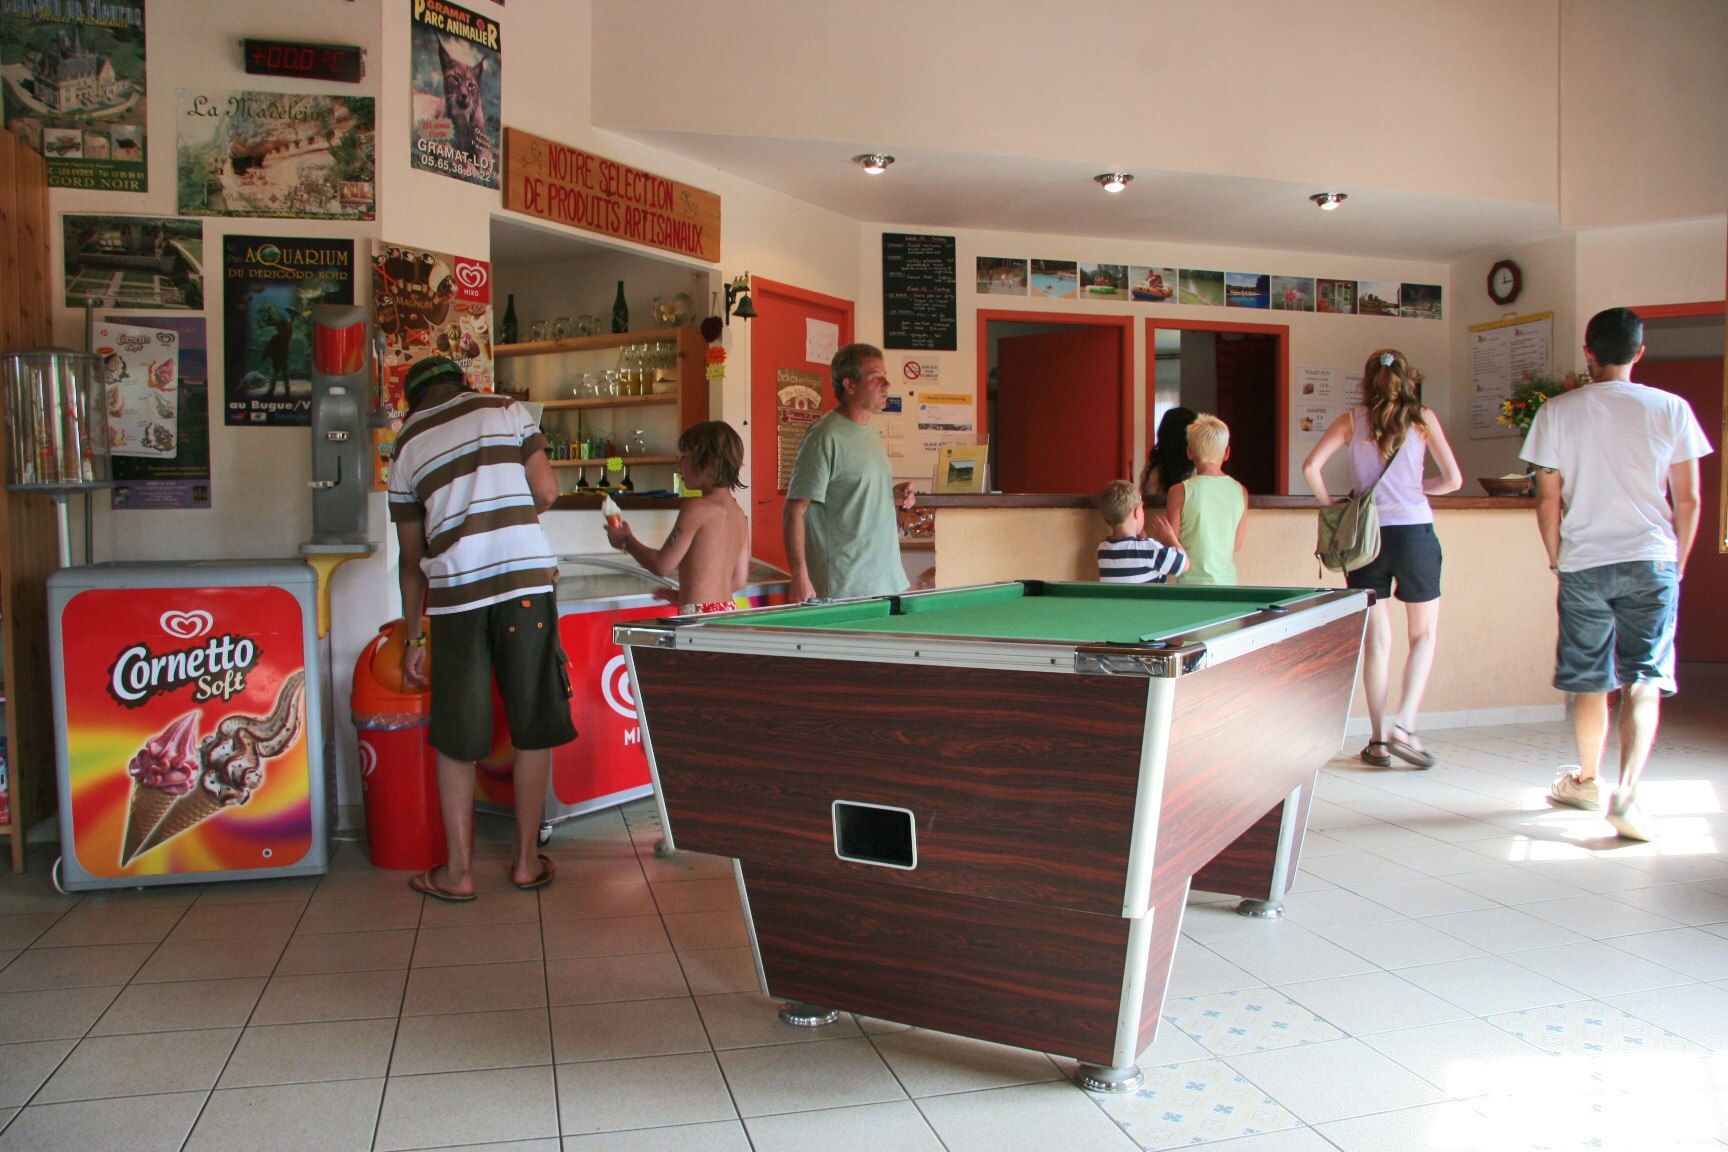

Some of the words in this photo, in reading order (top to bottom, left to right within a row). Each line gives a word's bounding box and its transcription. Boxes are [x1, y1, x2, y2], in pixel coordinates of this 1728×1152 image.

[414, 0, 445, 33] PARC
[446, 18, 497, 50] ANIMALIER
[427, 0, 471, 23] GRAMAT
[187, 96, 219, 118] La
[225, 96, 330, 122] Madeleine
[417, 138, 496, 171] GRAMAT-LOT
[100, 179, 140, 190] NOIR
[550, 145, 594, 190] NOTRE
[600, 160, 674, 213] SELECTION
[524, 176, 544, 214] DE
[549, 183, 620, 233] PRODUITS
[624, 208, 703, 255] ARTISANAUX
[245, 244, 349, 272] AQUARIUM
[228, 268, 244, 278] DU
[319, 271, 348, 281] NOIR
[463, 289, 479, 297] MIKO
[229, 402, 247, 410] au
[112, 635, 254, 700] Cornetto
[196, 670, 245, 701] Soft
